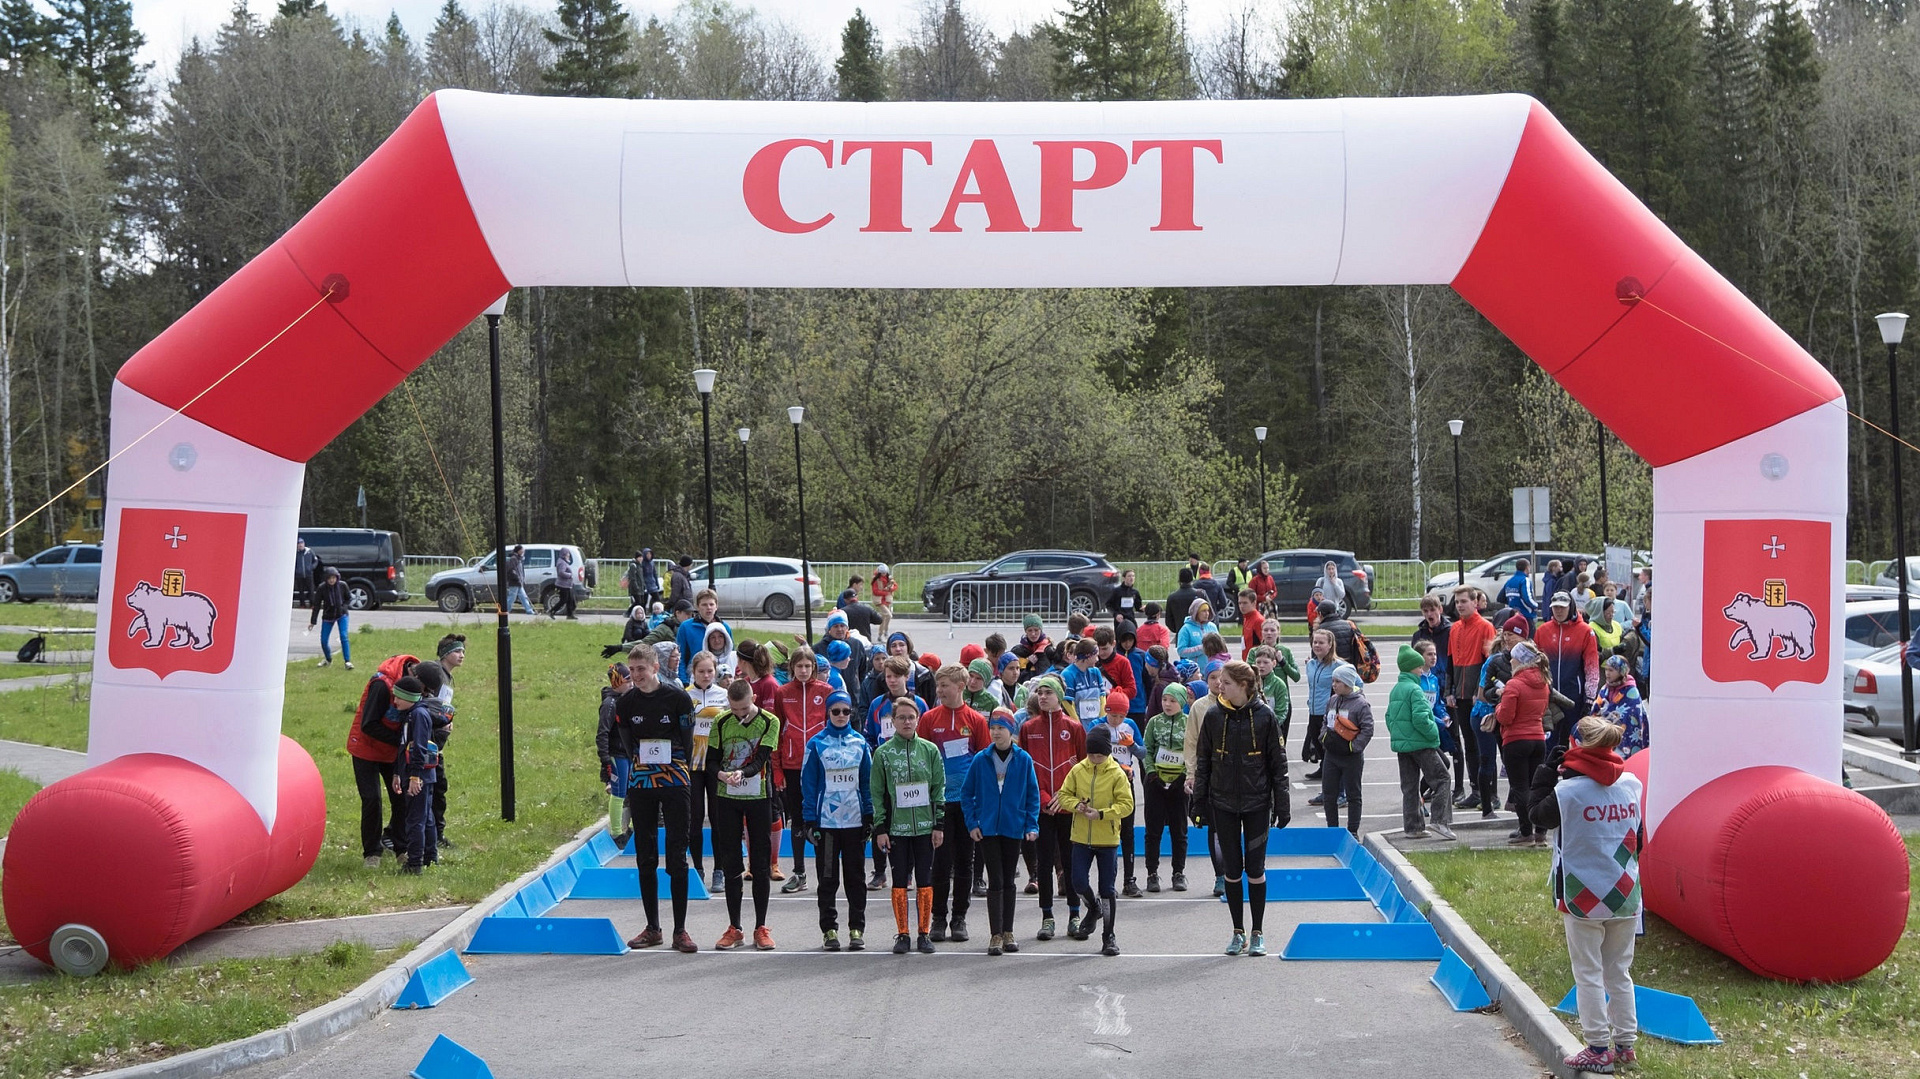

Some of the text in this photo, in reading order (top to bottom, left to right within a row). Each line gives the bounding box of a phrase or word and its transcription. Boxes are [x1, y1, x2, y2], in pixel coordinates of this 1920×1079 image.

[742, 137, 1224, 235] СТАРТ
[648, 746, 660, 756] 65
[1160, 753, 1179, 763] 4023
[832, 774, 855, 783] 1316
[903, 789, 920, 799] 909
[1582, 802, 1636, 823] СУДЬЯ
